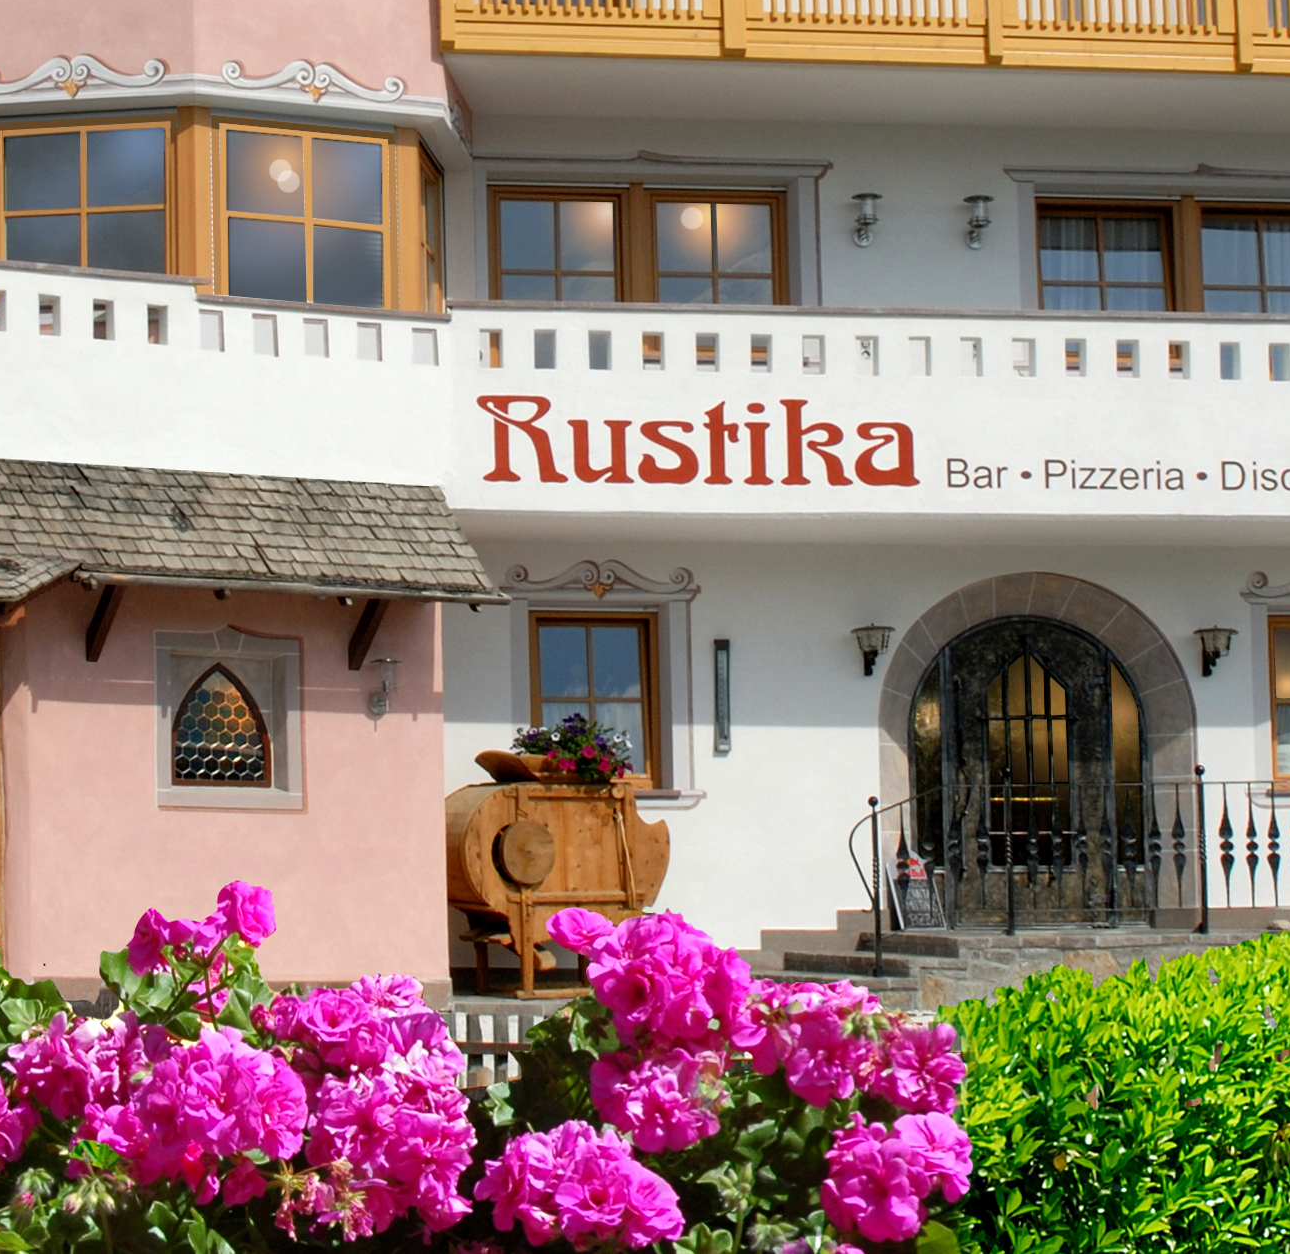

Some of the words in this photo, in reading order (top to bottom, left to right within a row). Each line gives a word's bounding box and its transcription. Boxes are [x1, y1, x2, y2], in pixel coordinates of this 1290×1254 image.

[477, 395, 920, 487] Rustika
[946, 458, 1008, 489] Bar
[1044, 459, 1185, 491] Pizzeria
